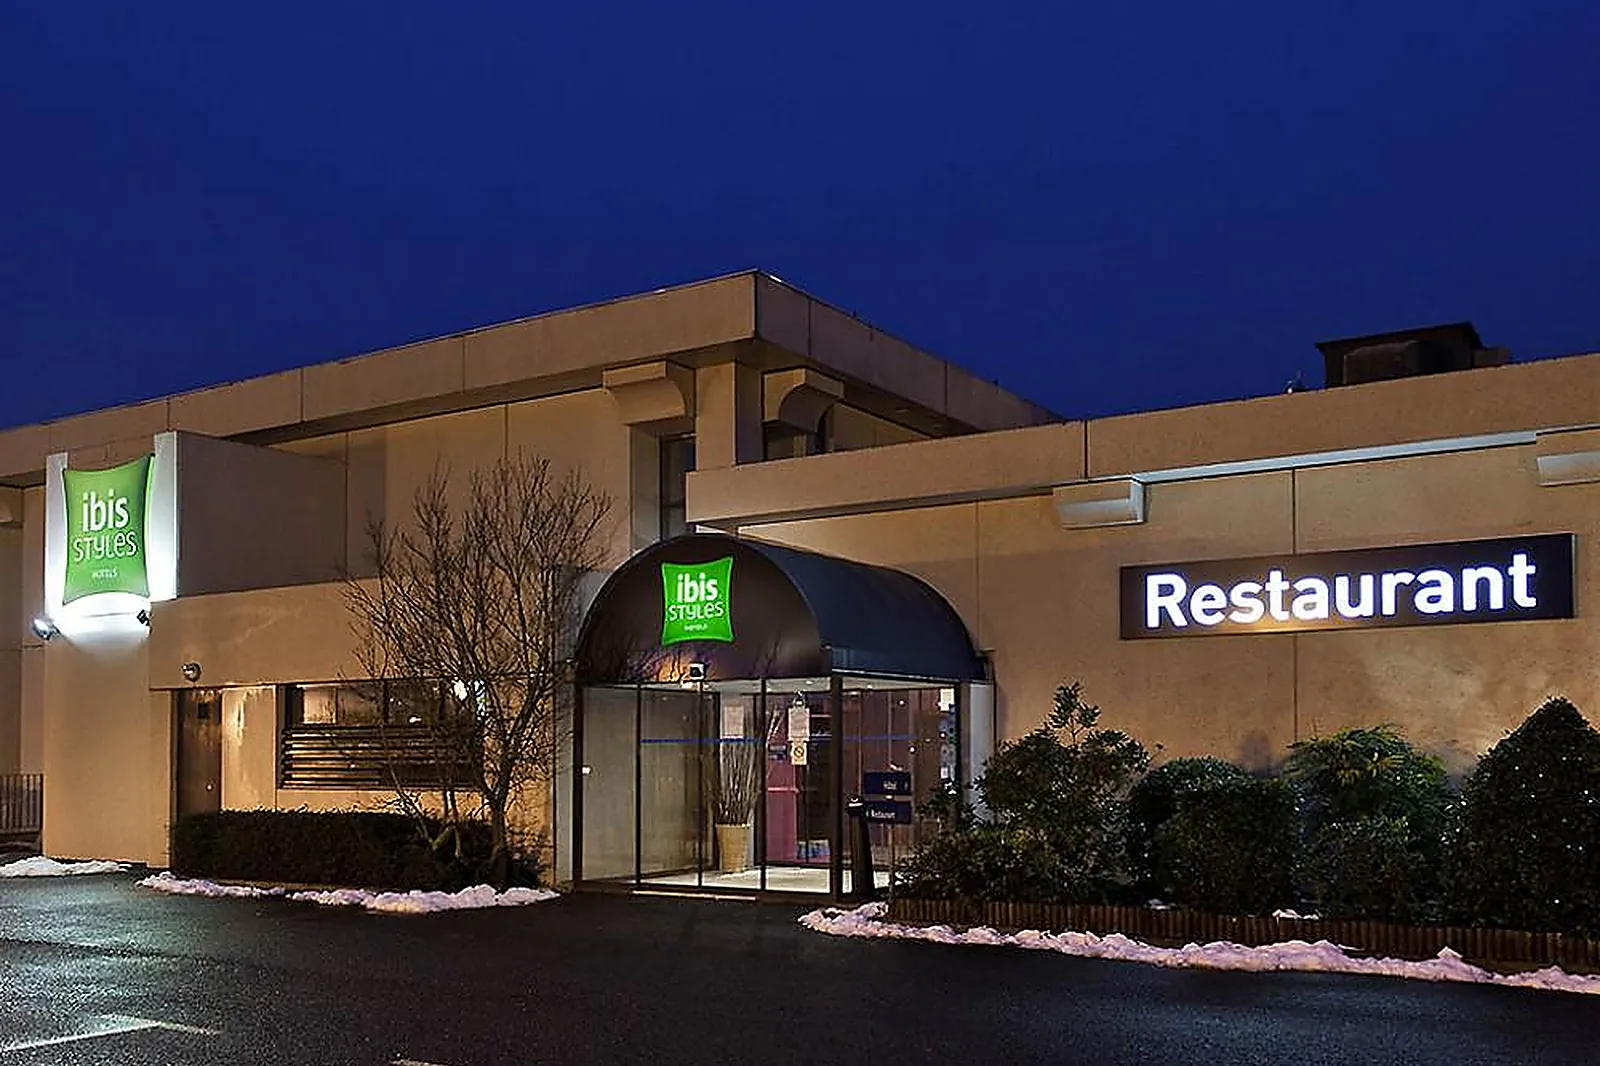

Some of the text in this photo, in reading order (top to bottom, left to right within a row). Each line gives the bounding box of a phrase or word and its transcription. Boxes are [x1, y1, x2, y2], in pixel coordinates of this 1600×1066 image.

[82, 489, 130, 532] ibis
[677, 572, 718, 602] ibis
[1146, 553, 1537, 628] Restaurant
